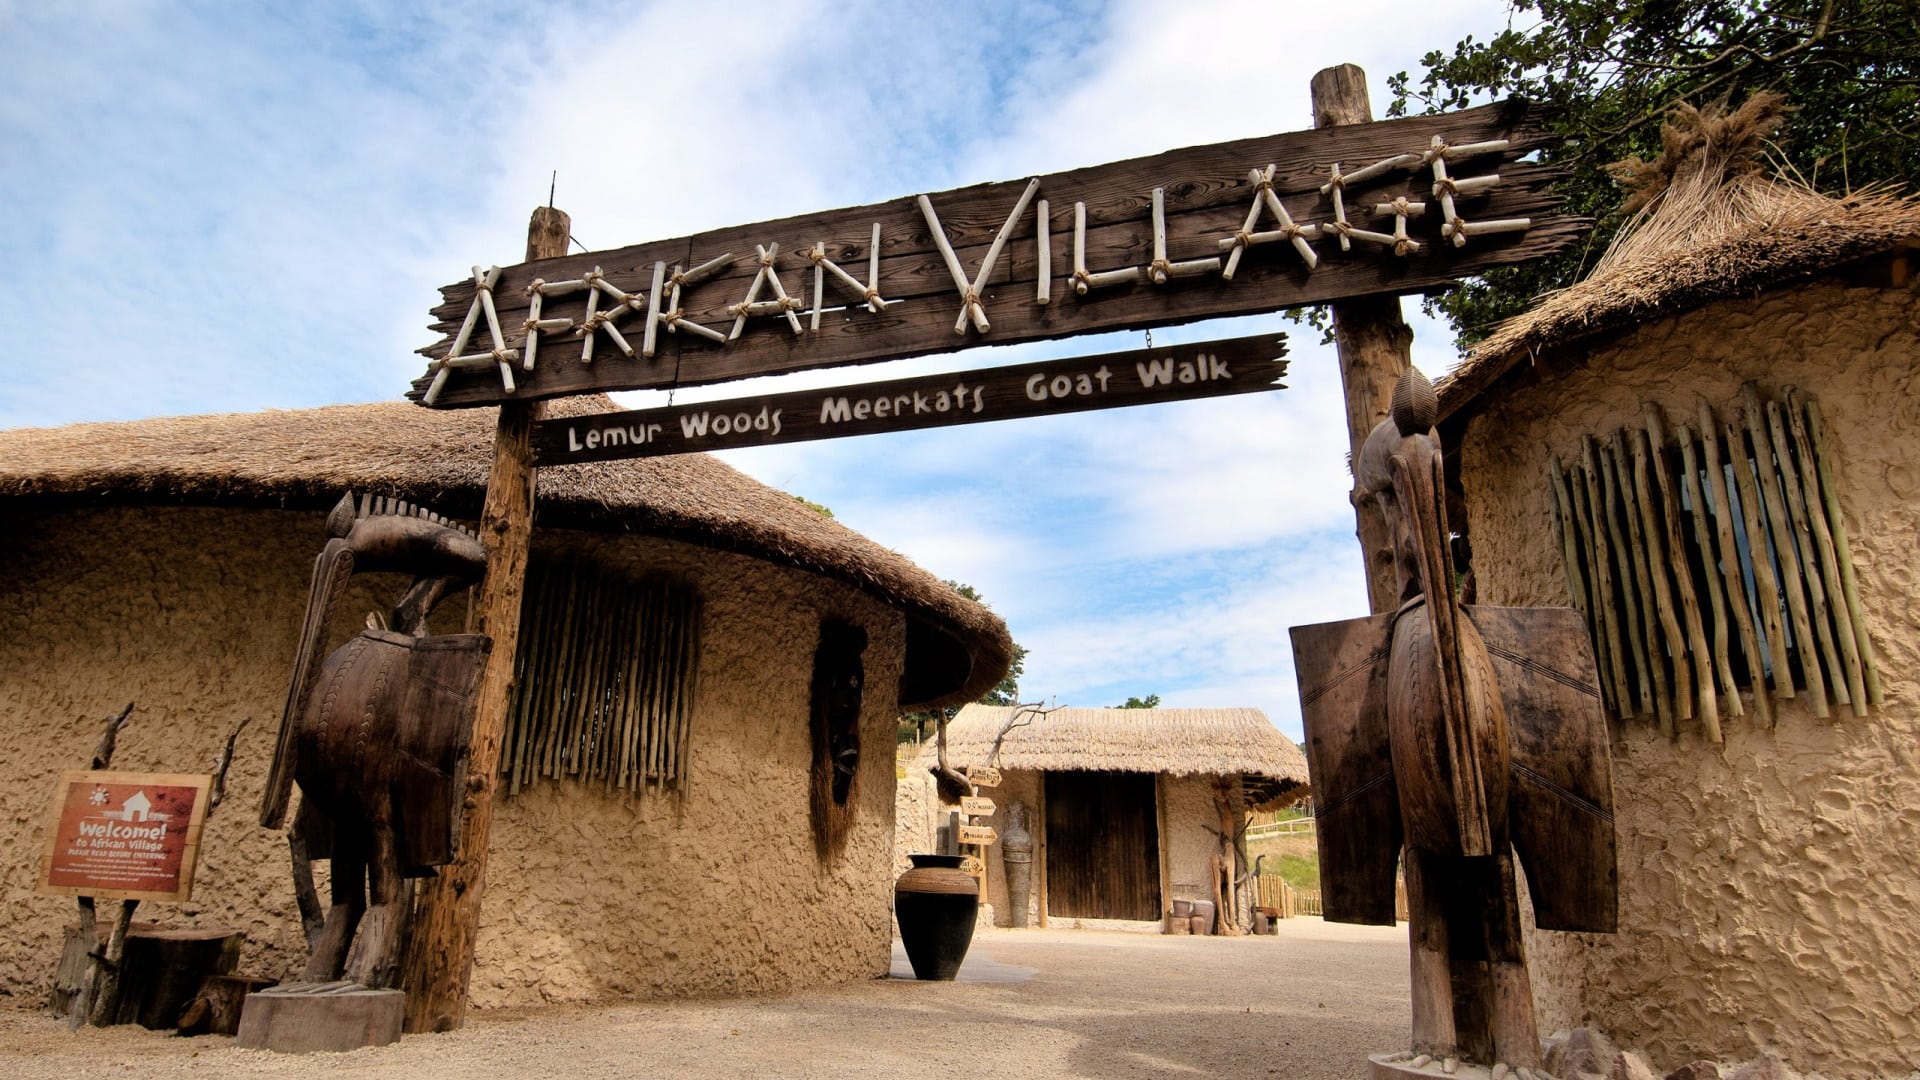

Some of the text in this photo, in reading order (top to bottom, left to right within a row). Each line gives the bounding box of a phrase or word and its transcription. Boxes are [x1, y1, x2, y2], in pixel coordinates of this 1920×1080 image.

[422, 134, 1531, 405] AFRICAN VILLAGE
[568, 353, 1233, 453] Lemur Woods Meerkats Goat Walk
[80, 820, 168, 840] Welcome!
[77, 838, 163, 852] to African Village
[109, 850, 131, 858] BEFORE
